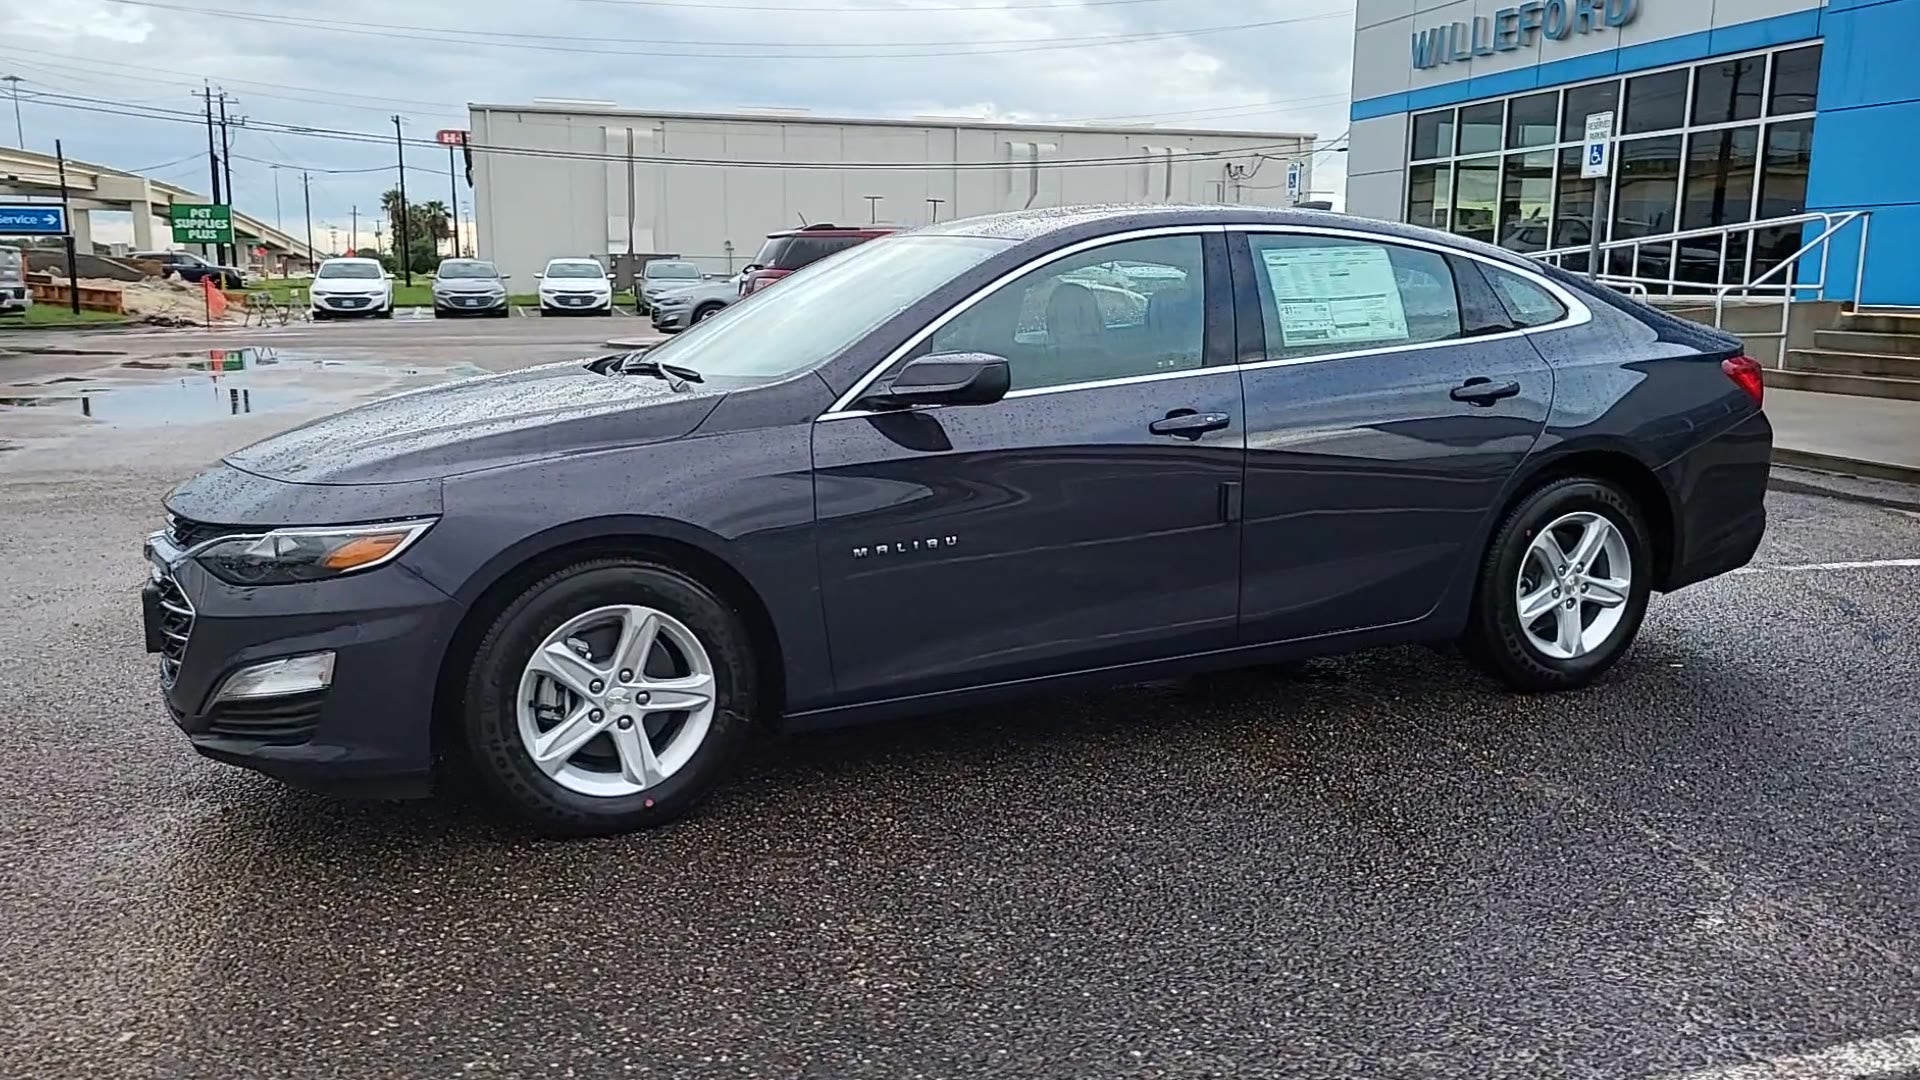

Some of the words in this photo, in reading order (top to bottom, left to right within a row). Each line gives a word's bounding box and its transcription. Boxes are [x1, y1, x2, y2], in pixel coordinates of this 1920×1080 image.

[1411, 0, 1639, 69] WILLEFORD
[190, 208, 212, 218] PET
[174, 218, 229, 229] SUPPLIES
[188, 229, 217, 239] PLUS
[853, 535, 957, 558] MALIBU
